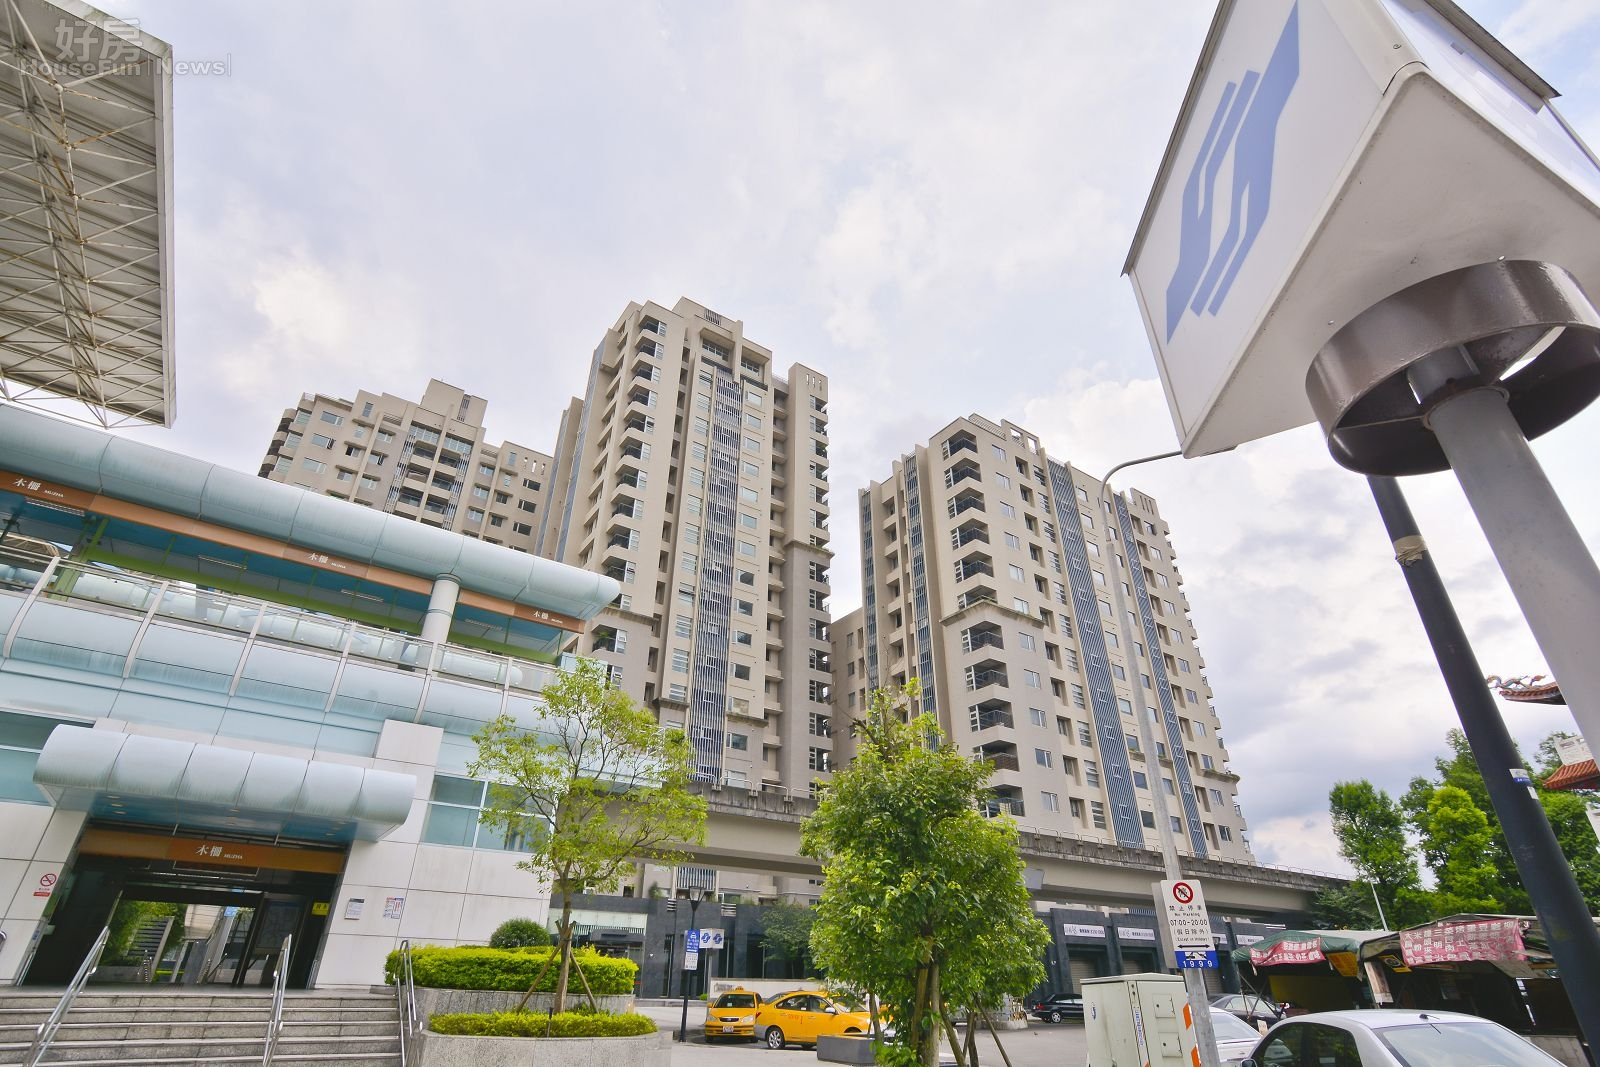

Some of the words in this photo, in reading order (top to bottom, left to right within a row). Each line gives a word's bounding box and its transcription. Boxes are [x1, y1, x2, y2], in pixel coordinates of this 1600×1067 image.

[12, 478, 42, 491] 木柵
[309, 553, 328, 563] 木柵
[195, 844, 223, 857] 木柵
[1182, 960, 1213, 968] 1999
